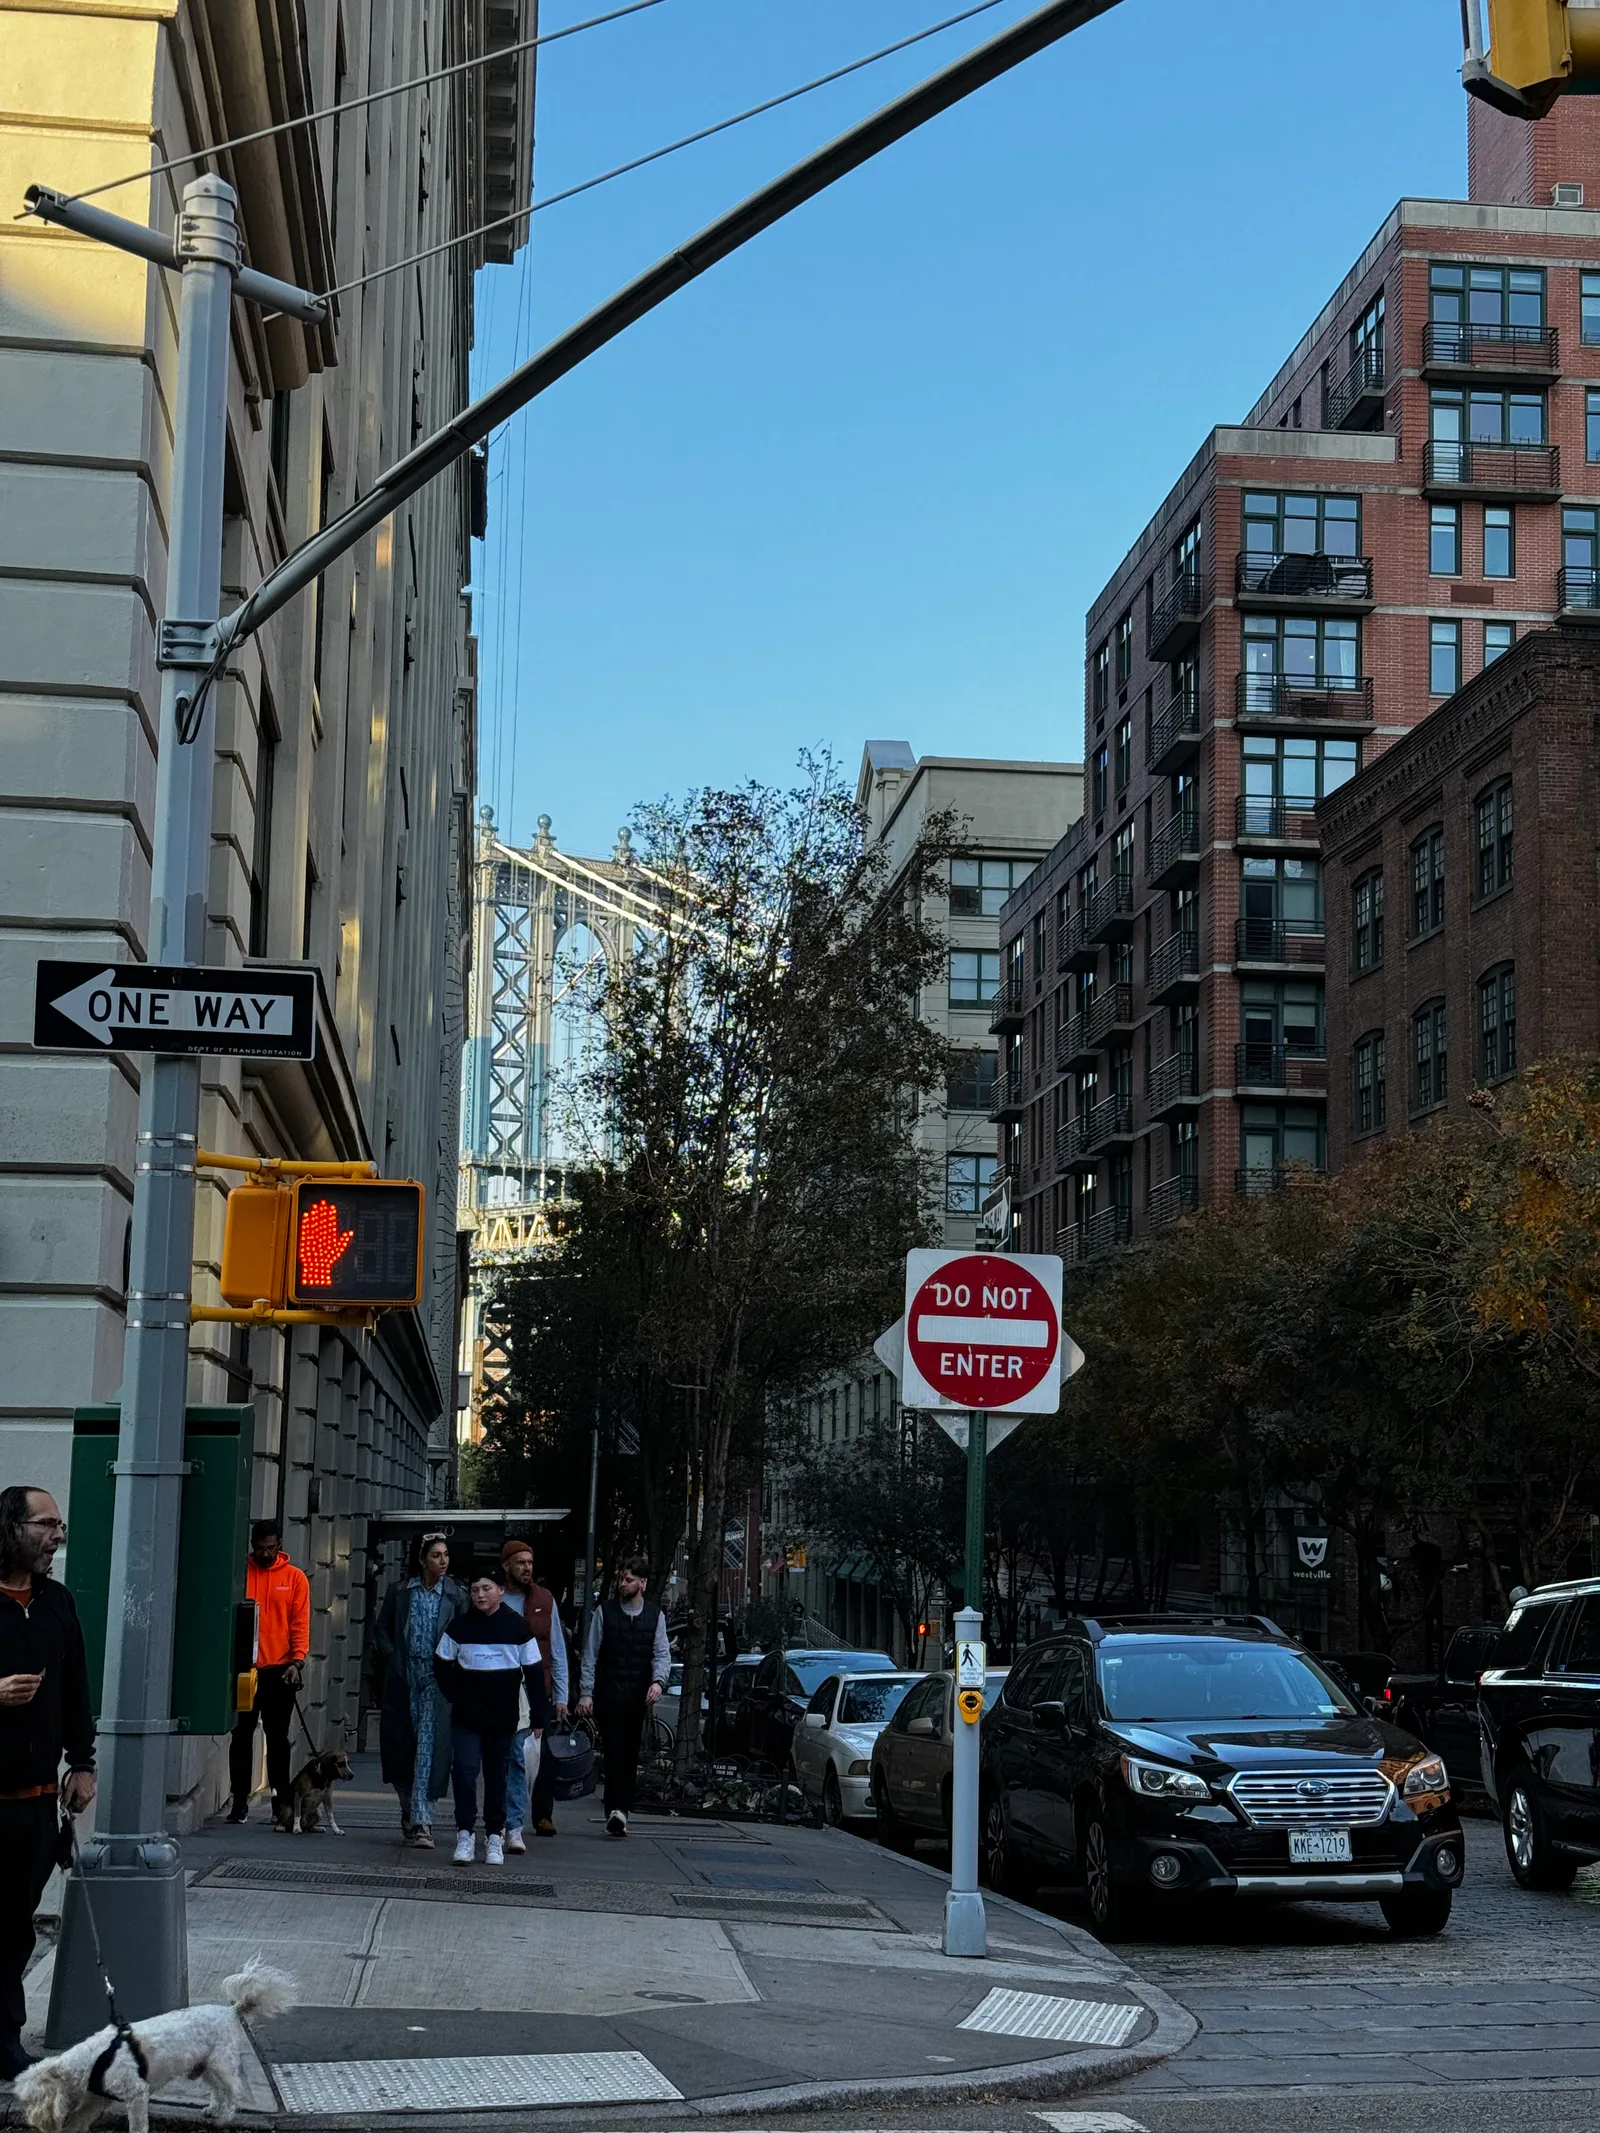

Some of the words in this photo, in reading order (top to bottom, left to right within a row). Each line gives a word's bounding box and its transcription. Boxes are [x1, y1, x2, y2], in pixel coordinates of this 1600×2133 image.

[88, 990, 170, 1025] ONE
[194, 995, 277, 1030] WAY
[188, 1045, 209, 1053] DEPT
[228, 1047, 302, 1057] TRANSPORTATION
[935, 1283, 970, 1308] DO
[982, 1286, 1032, 1311] NOT
[940, 1352, 1023, 1379] ENTER
[434, 1525, 455, 1537] 70
[1292, 1569, 1332, 1579] westville
